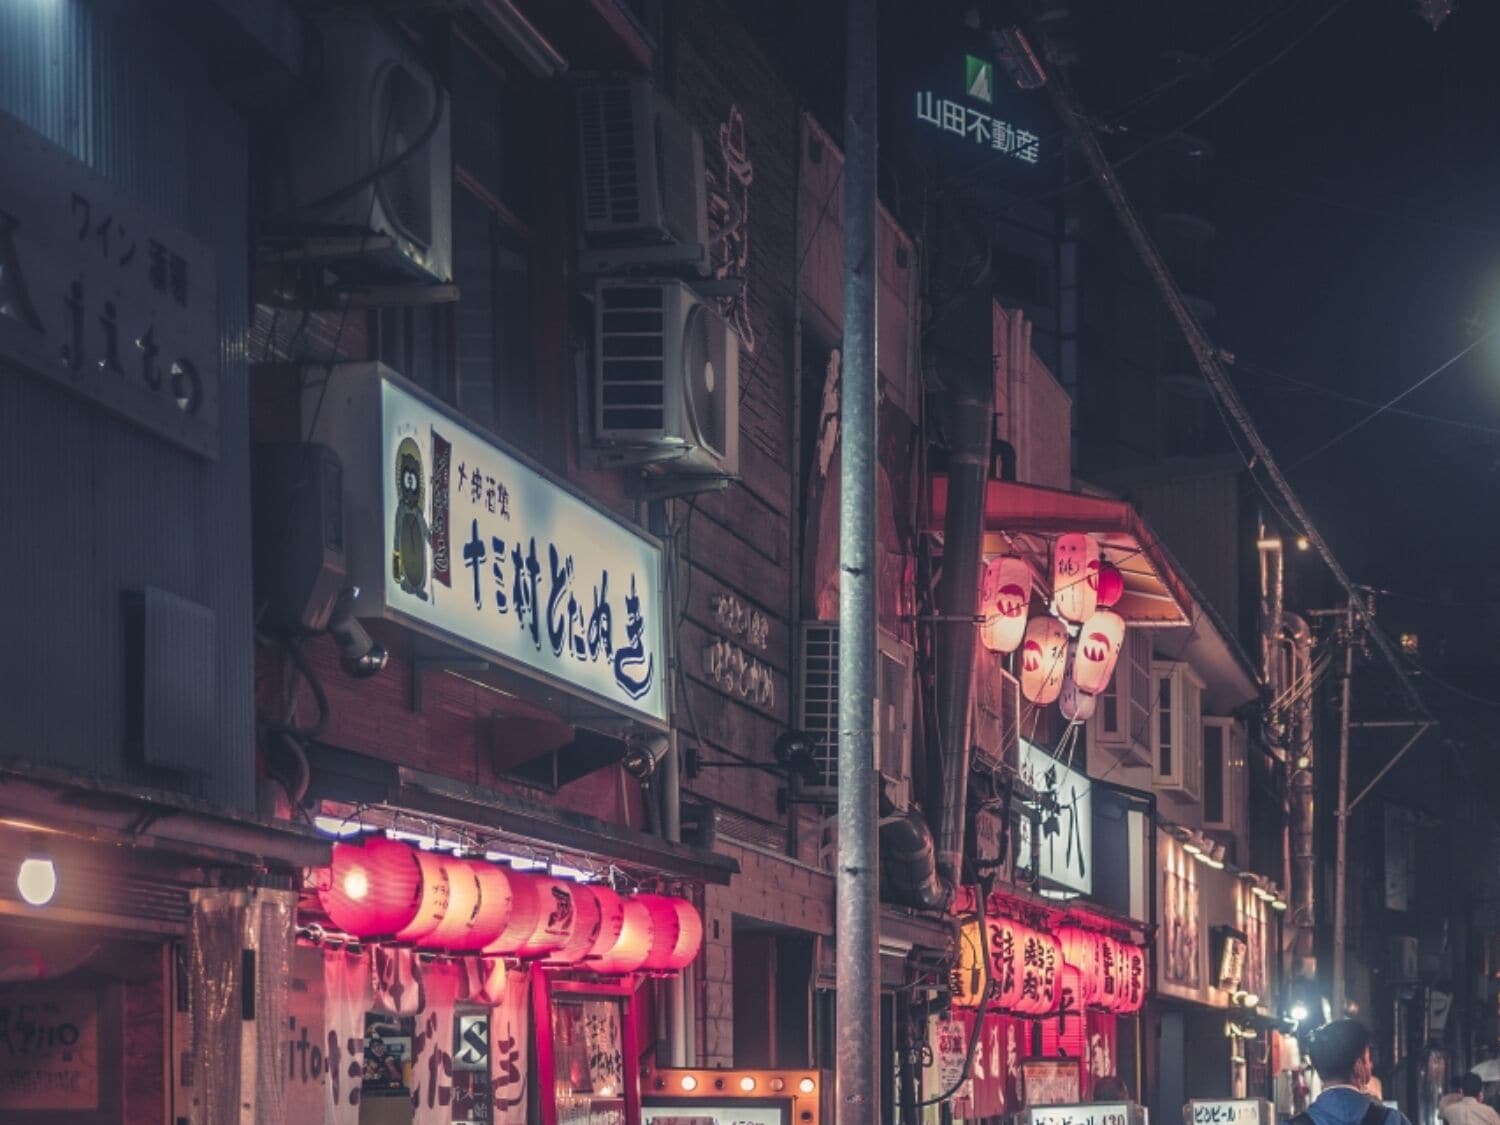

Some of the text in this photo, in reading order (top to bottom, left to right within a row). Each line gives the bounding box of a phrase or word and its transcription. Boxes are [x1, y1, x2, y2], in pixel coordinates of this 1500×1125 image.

[916, 91, 1040, 164] 山田不動産
